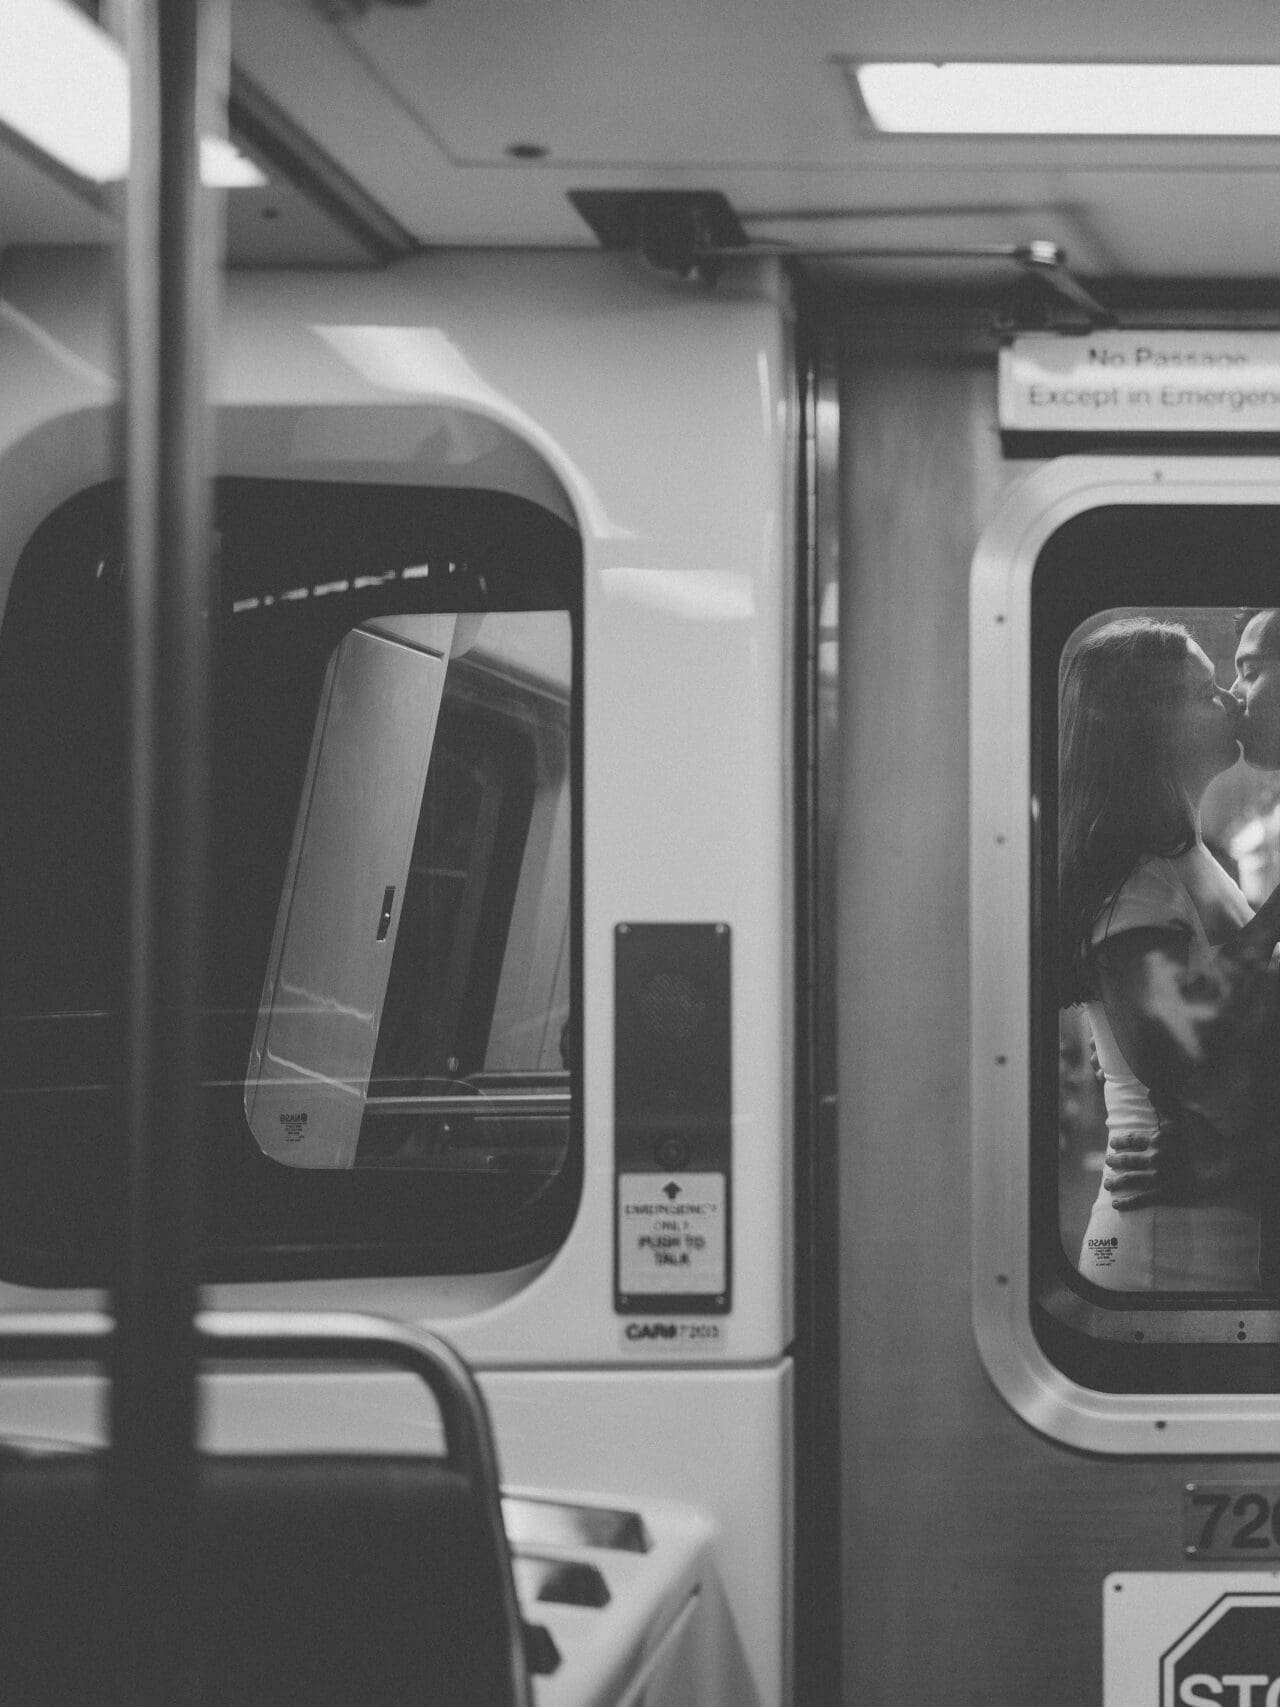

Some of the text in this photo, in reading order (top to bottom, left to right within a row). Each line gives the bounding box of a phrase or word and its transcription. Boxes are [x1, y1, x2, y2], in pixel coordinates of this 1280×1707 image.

[1088, 348, 1125, 366] No
[1029, 385, 1118, 408] Except
[1128, 387, 1151, 406] in
